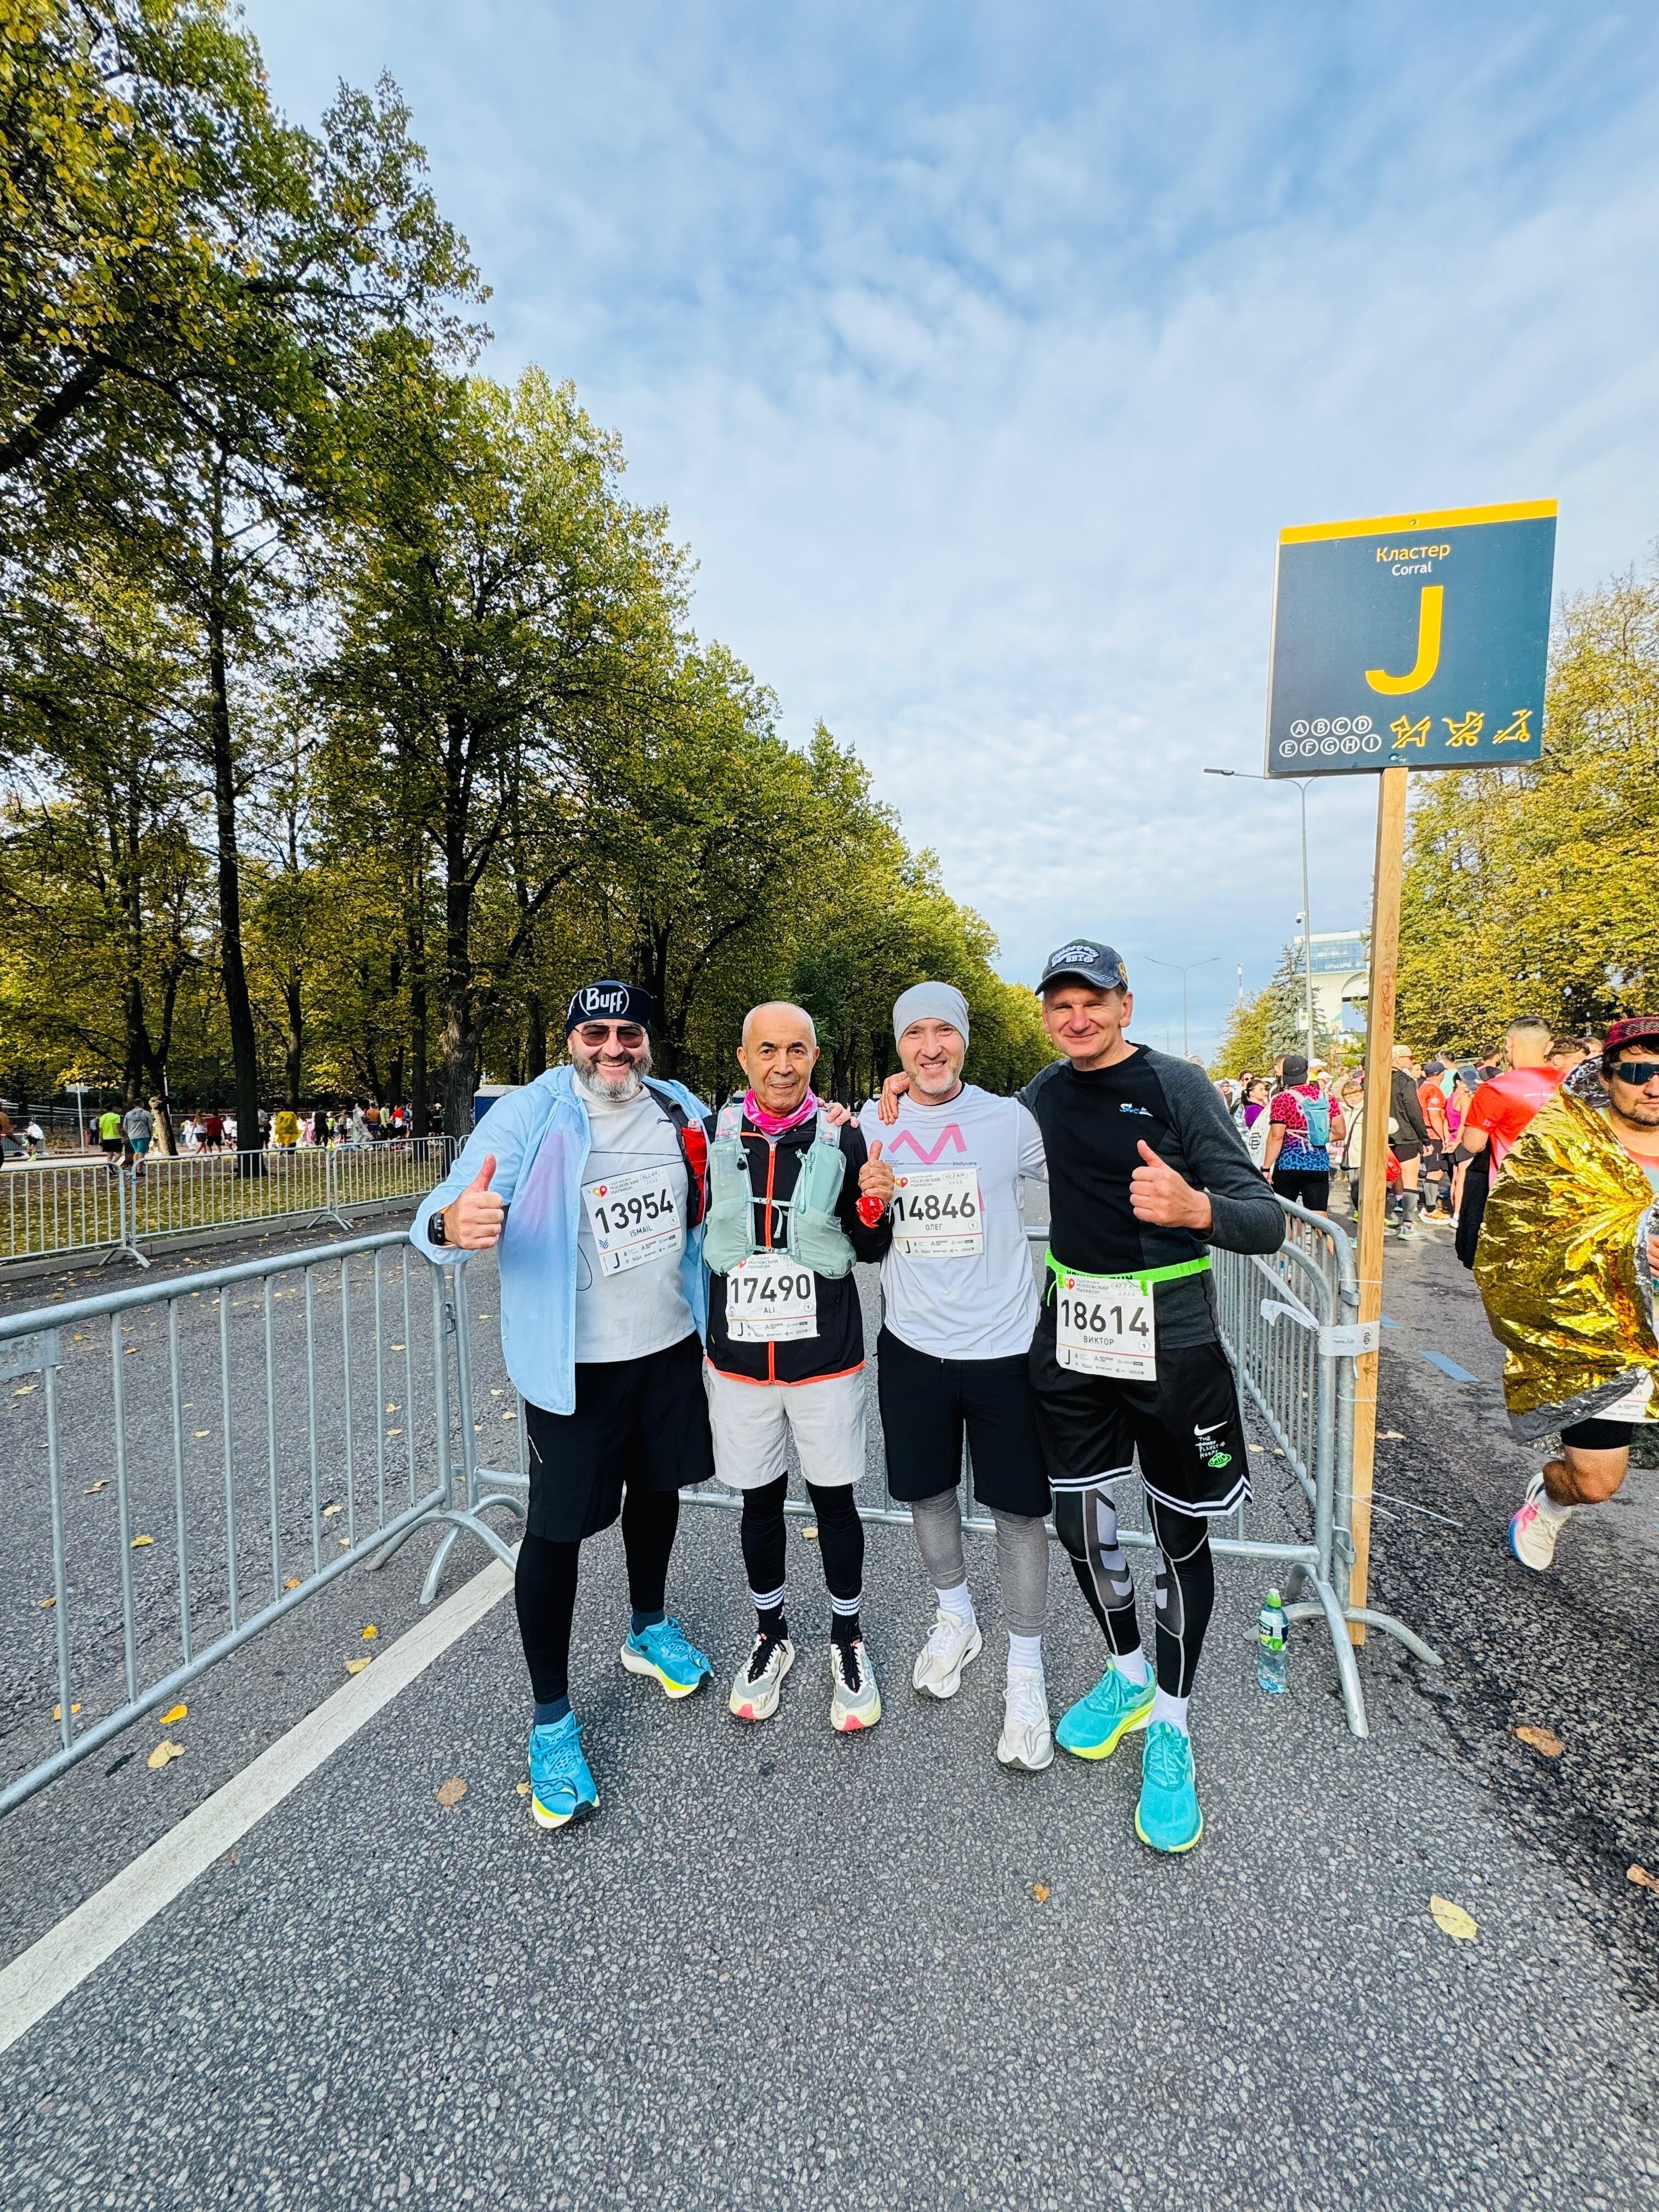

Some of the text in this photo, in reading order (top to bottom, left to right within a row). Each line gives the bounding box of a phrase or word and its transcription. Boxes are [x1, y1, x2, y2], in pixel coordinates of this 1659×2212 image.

[1376, 544, 1451, 562] Кластер
[1391, 561, 1432, 576] Corral
[1365, 585, 1444, 695] J
[595, 1189, 674, 1234] 13954
[894, 1192, 975, 1221] 14846
[629, 1224, 653, 1237] ISMAIL
[906, 1240, 911, 1254] J
[613, 1252, 620, 1269] J
[731, 1274, 811, 1304] 17490
[1061, 1299, 1149, 1336] 18614
[737, 1322, 743, 1336] J
[1084, 1335, 1114, 1346] ВИКТОР
[1065, 1350, 1070, 1365] J
